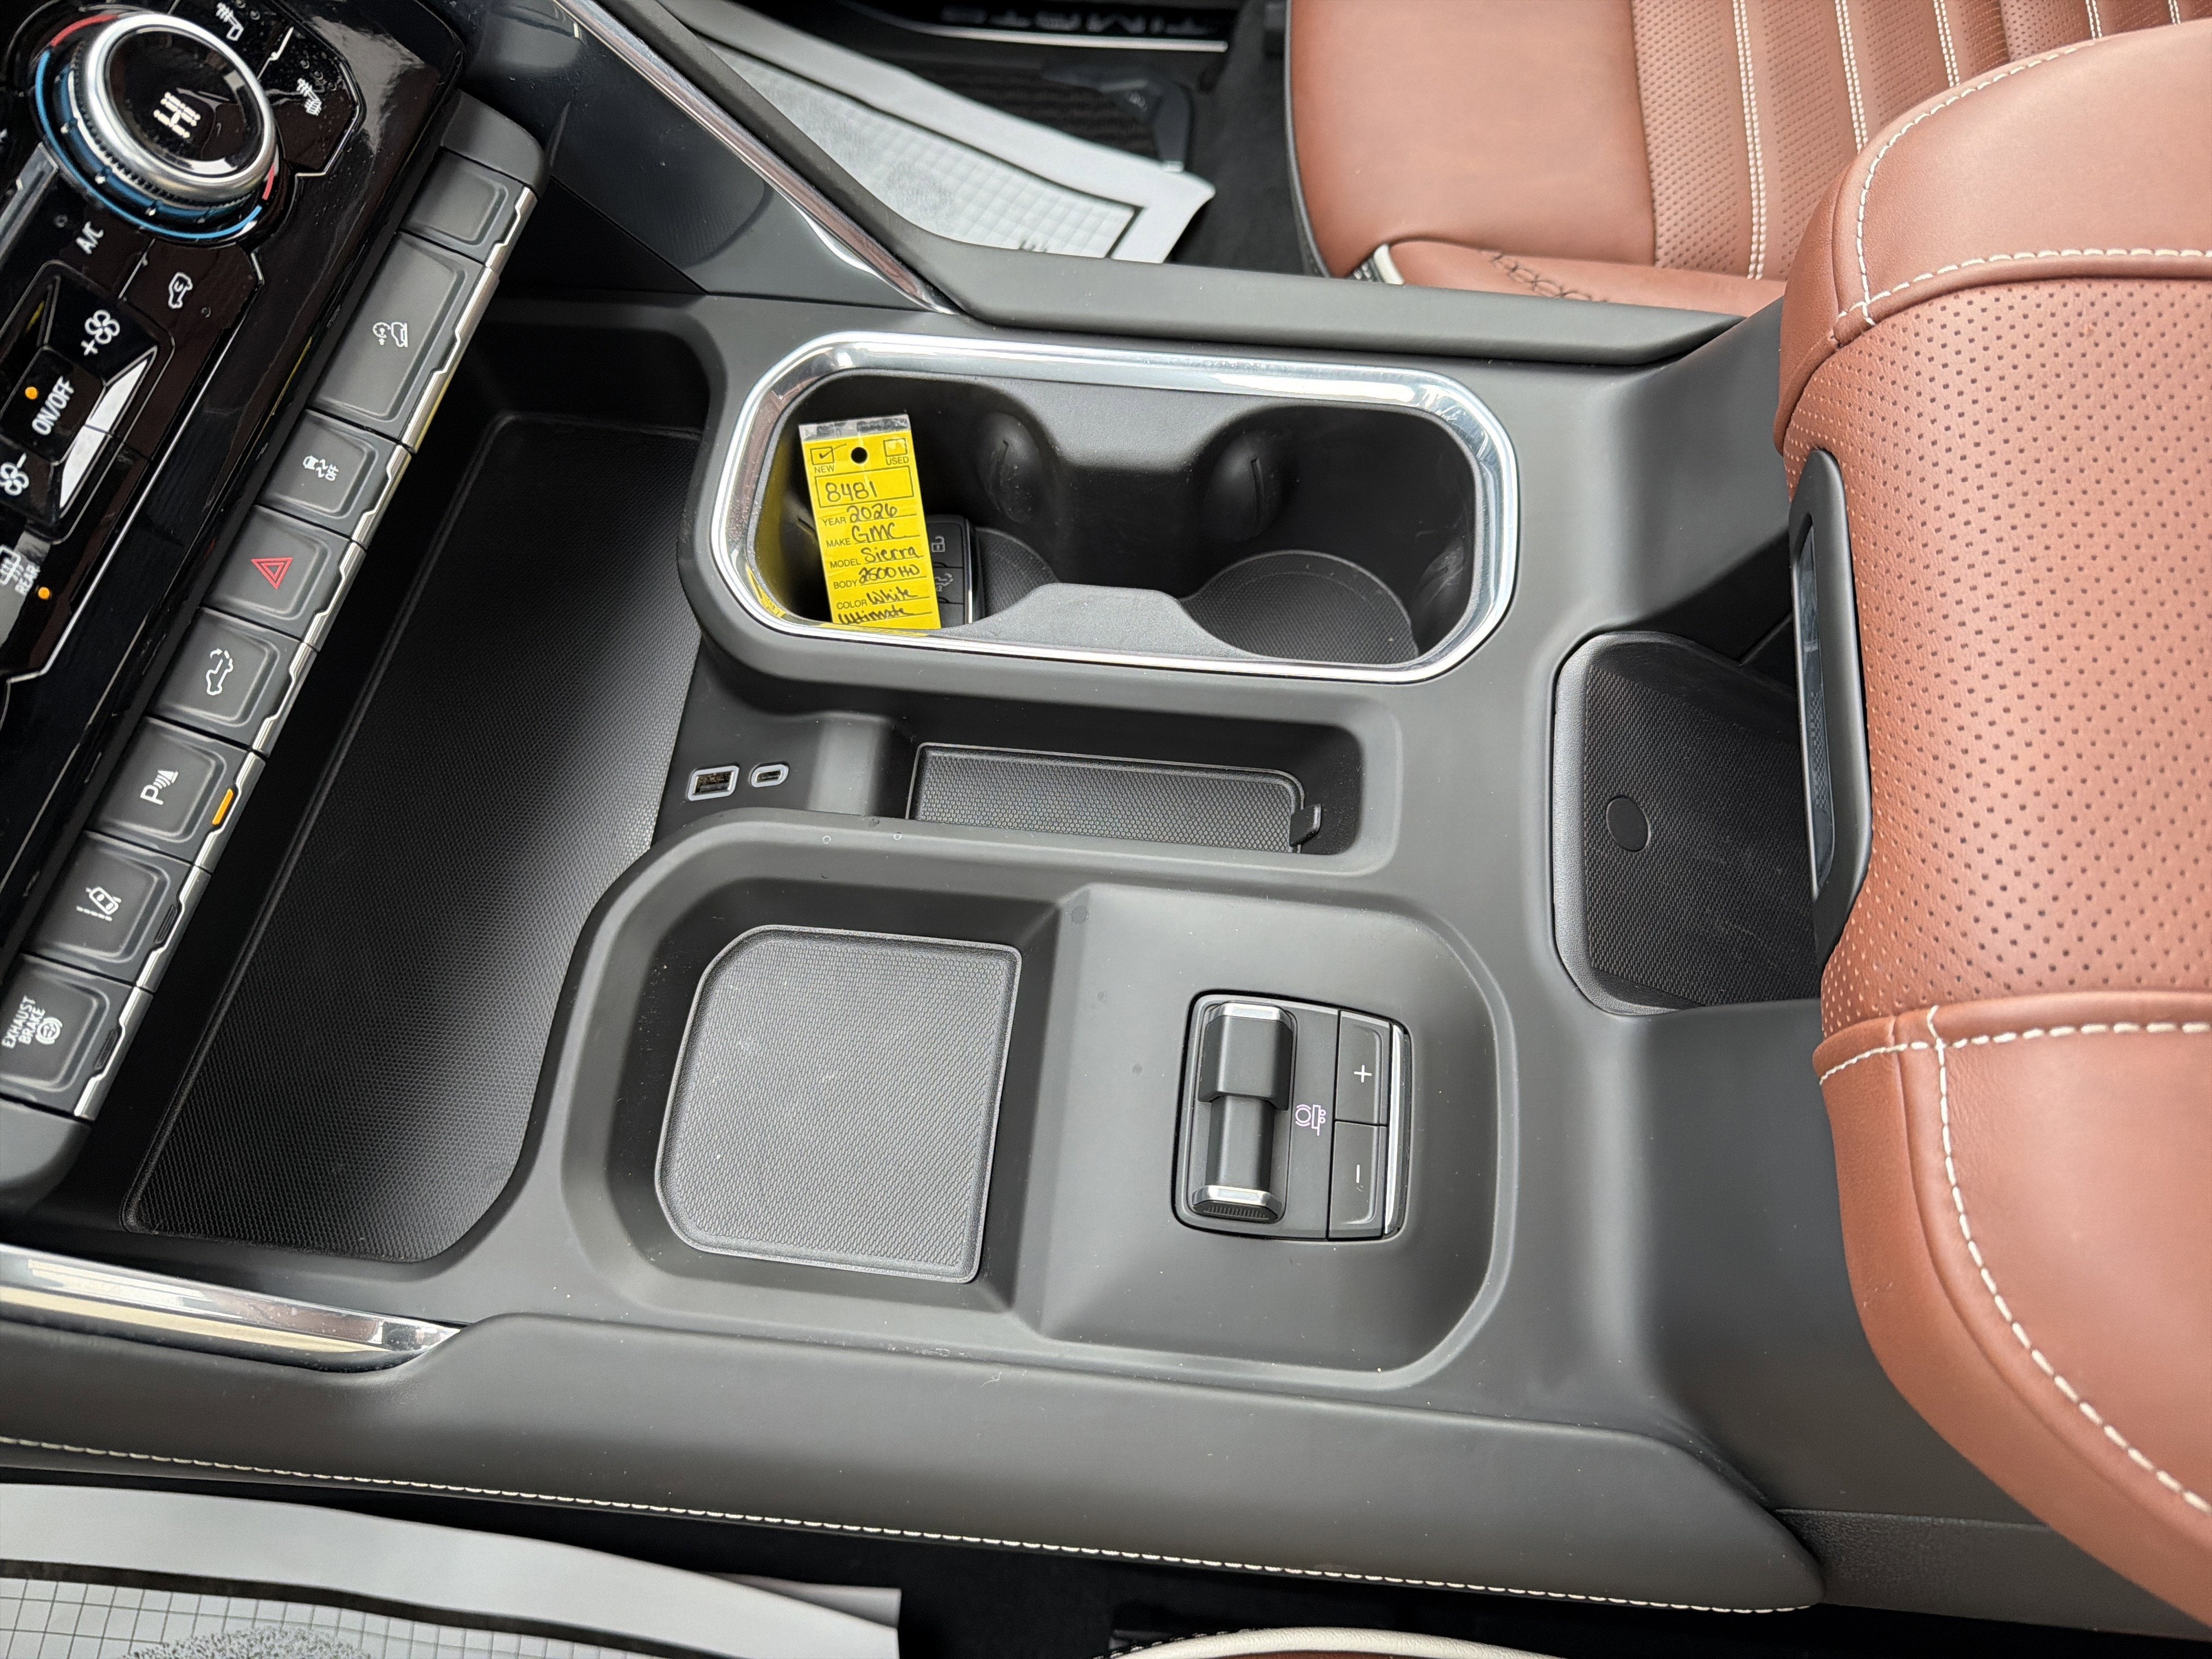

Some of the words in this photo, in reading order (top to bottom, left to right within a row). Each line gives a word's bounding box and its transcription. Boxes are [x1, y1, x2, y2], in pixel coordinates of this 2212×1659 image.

[153, 92, 201, 138] HI
[76, 221, 104, 255] A/C
[32, 375, 75, 436] ON/OFF
[814, 465, 835, 474] NEW
[885, 456, 909, 465] USED
[325, 464, 339, 482] OFF
[825, 481, 878, 503] 8481
[822, 517, 847, 526] YEAR
[847, 503, 898, 523] 2026
[826, 538, 851, 548] MAKE
[851, 523, 901, 544] GMC
[830, 558, 861, 568] MODEL
[861, 547, 921, 563] Sierra
[15, 563, 41, 597] REAR
[834, 579, 857, 589] BODY
[837, 599, 867, 610] COLOR
[867, 586, 916, 604] White
[2, 995, 36, 1049] EXHAUST
[18, 1006, 46, 1045] BRAKE
